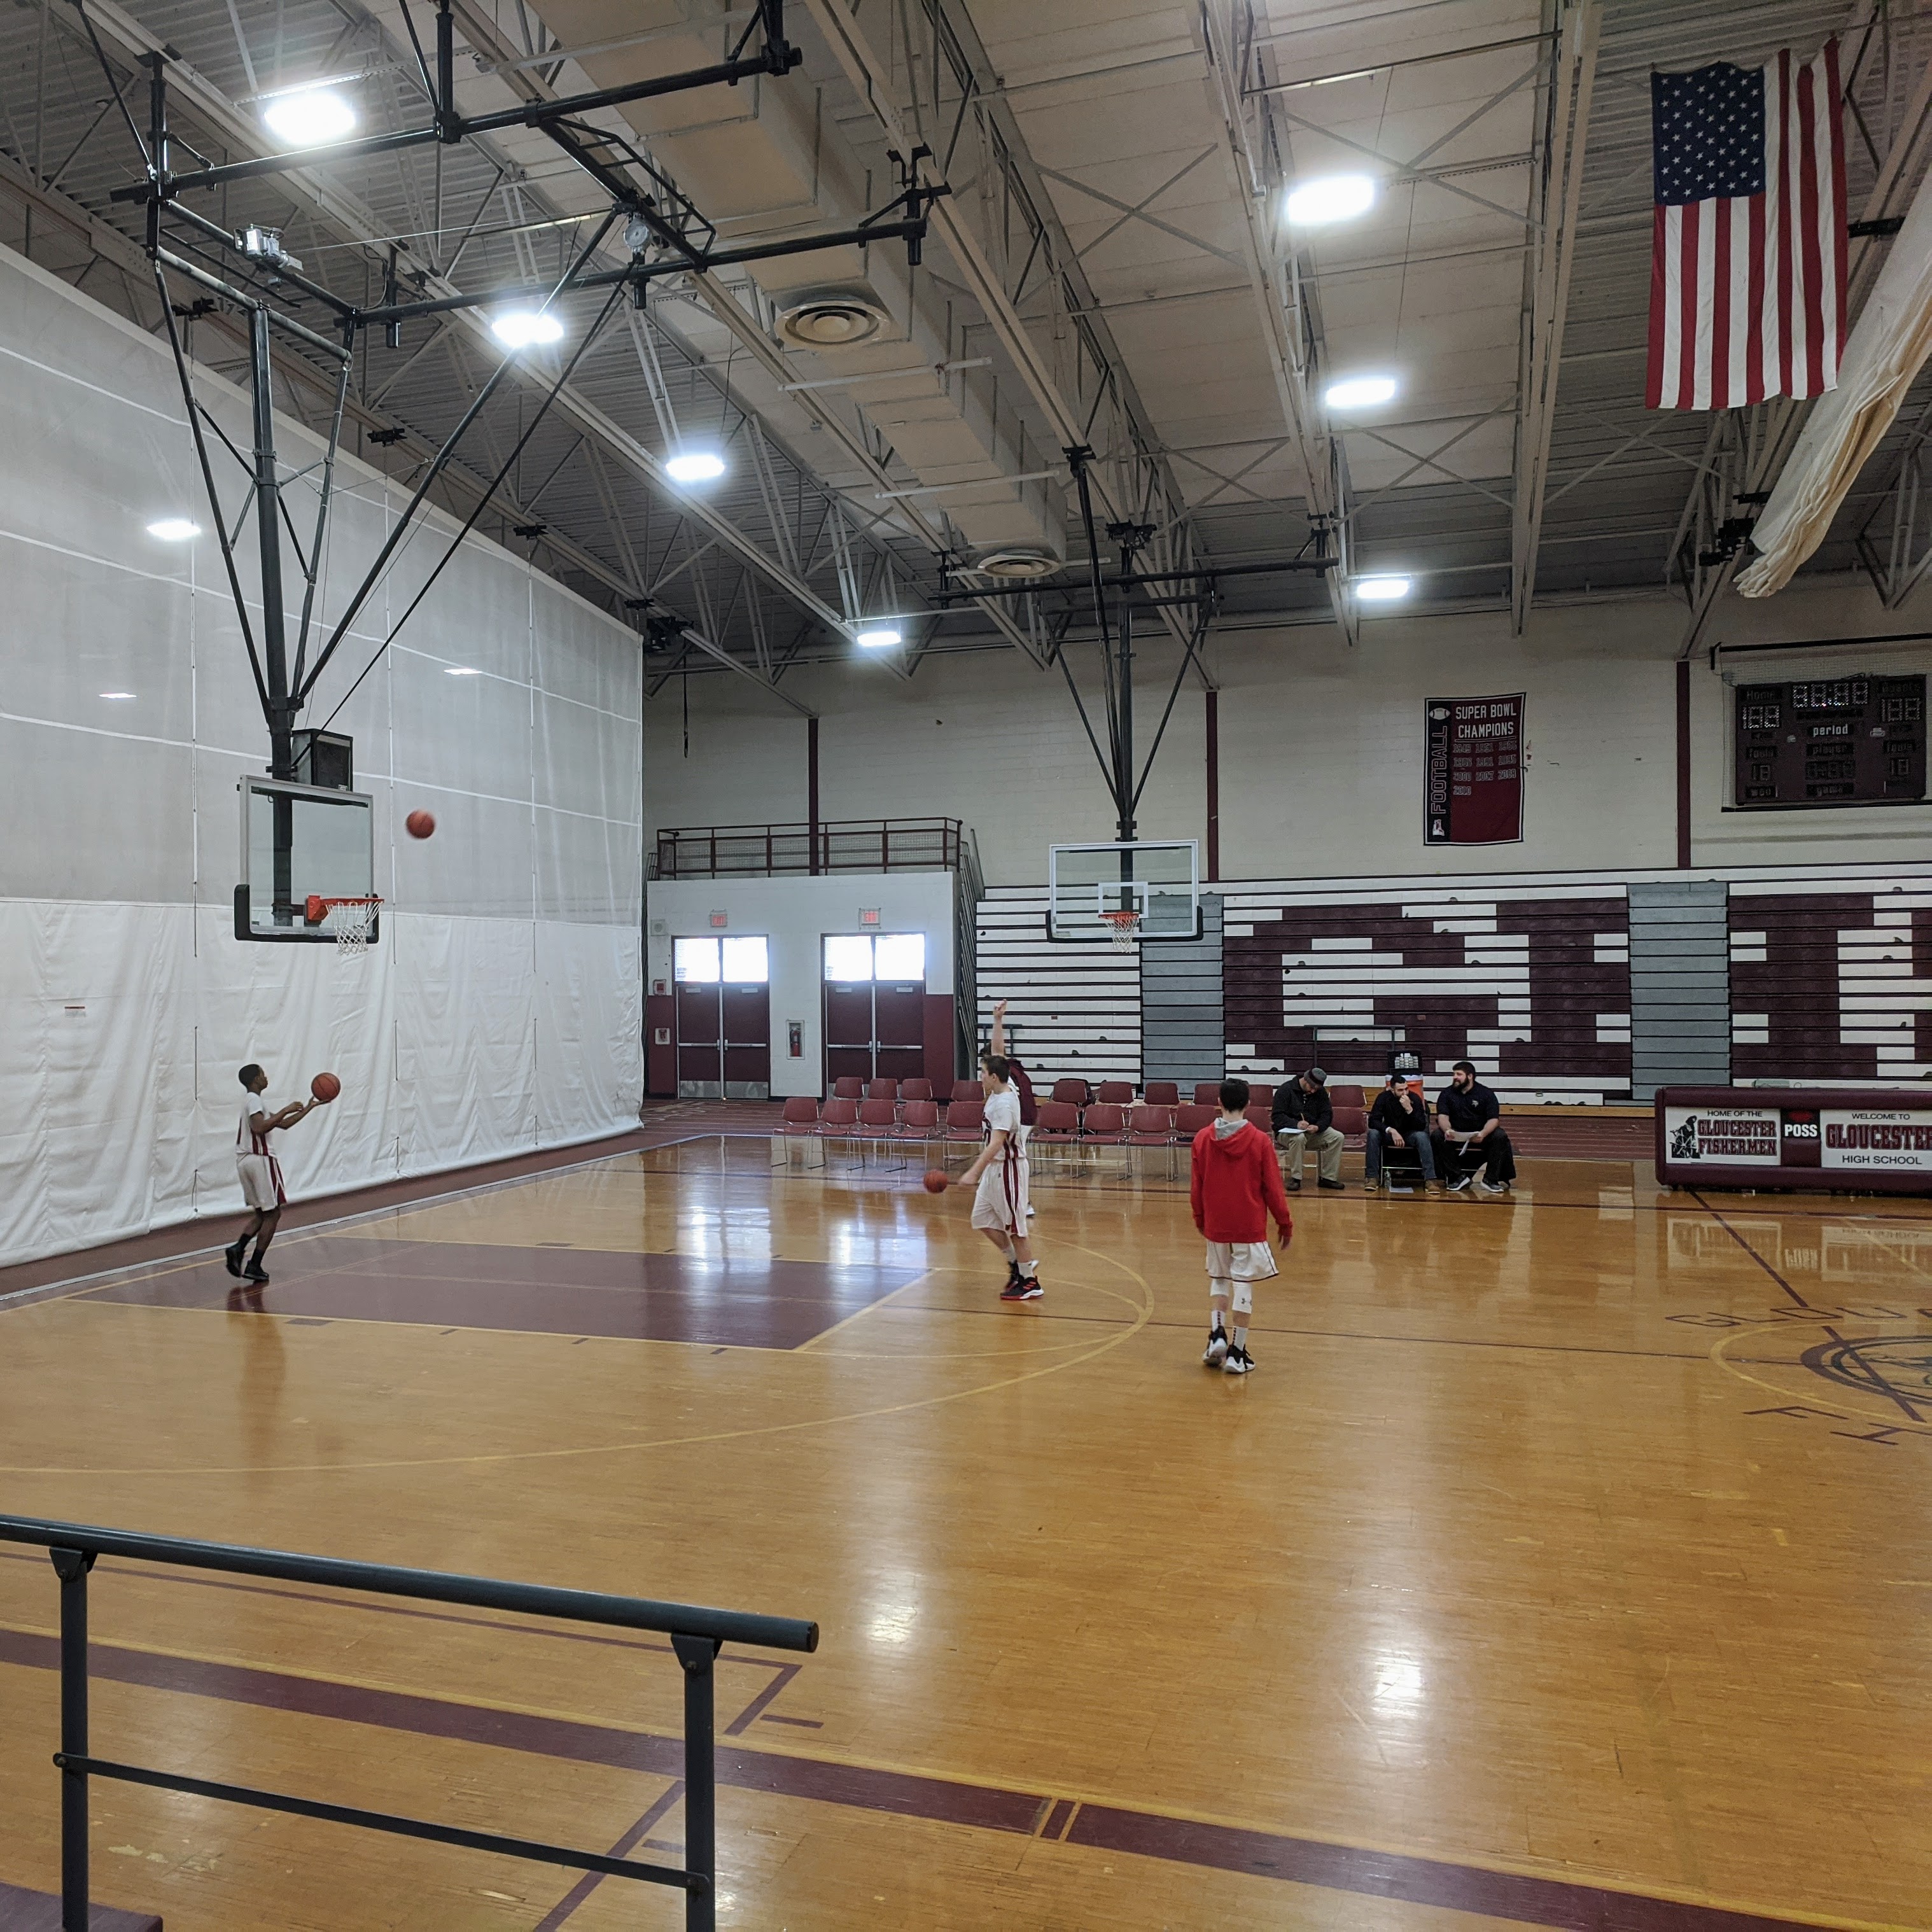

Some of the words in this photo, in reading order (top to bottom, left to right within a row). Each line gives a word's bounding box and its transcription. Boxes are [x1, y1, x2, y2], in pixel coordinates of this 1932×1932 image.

[1455, 705, 1487, 720] SUPER
[1490, 703, 1517, 718] BOWL
[1458, 722, 1515, 738] CHAMPIONS
[1813, 724, 1849, 737] period
[1431, 725, 1448, 814] FOOTBALL
[1697, 1119, 1777, 1137] GLOUCESTER
[1784, 1124, 1817, 1137] POSS
[1826, 1124, 1932, 1151] GLOUCESTE
[1698, 1138, 1777, 1156] FISHERMEN
[1842, 1155, 1870, 1164] HIGH
[1873, 1156, 1922, 1165] SCHOOL
